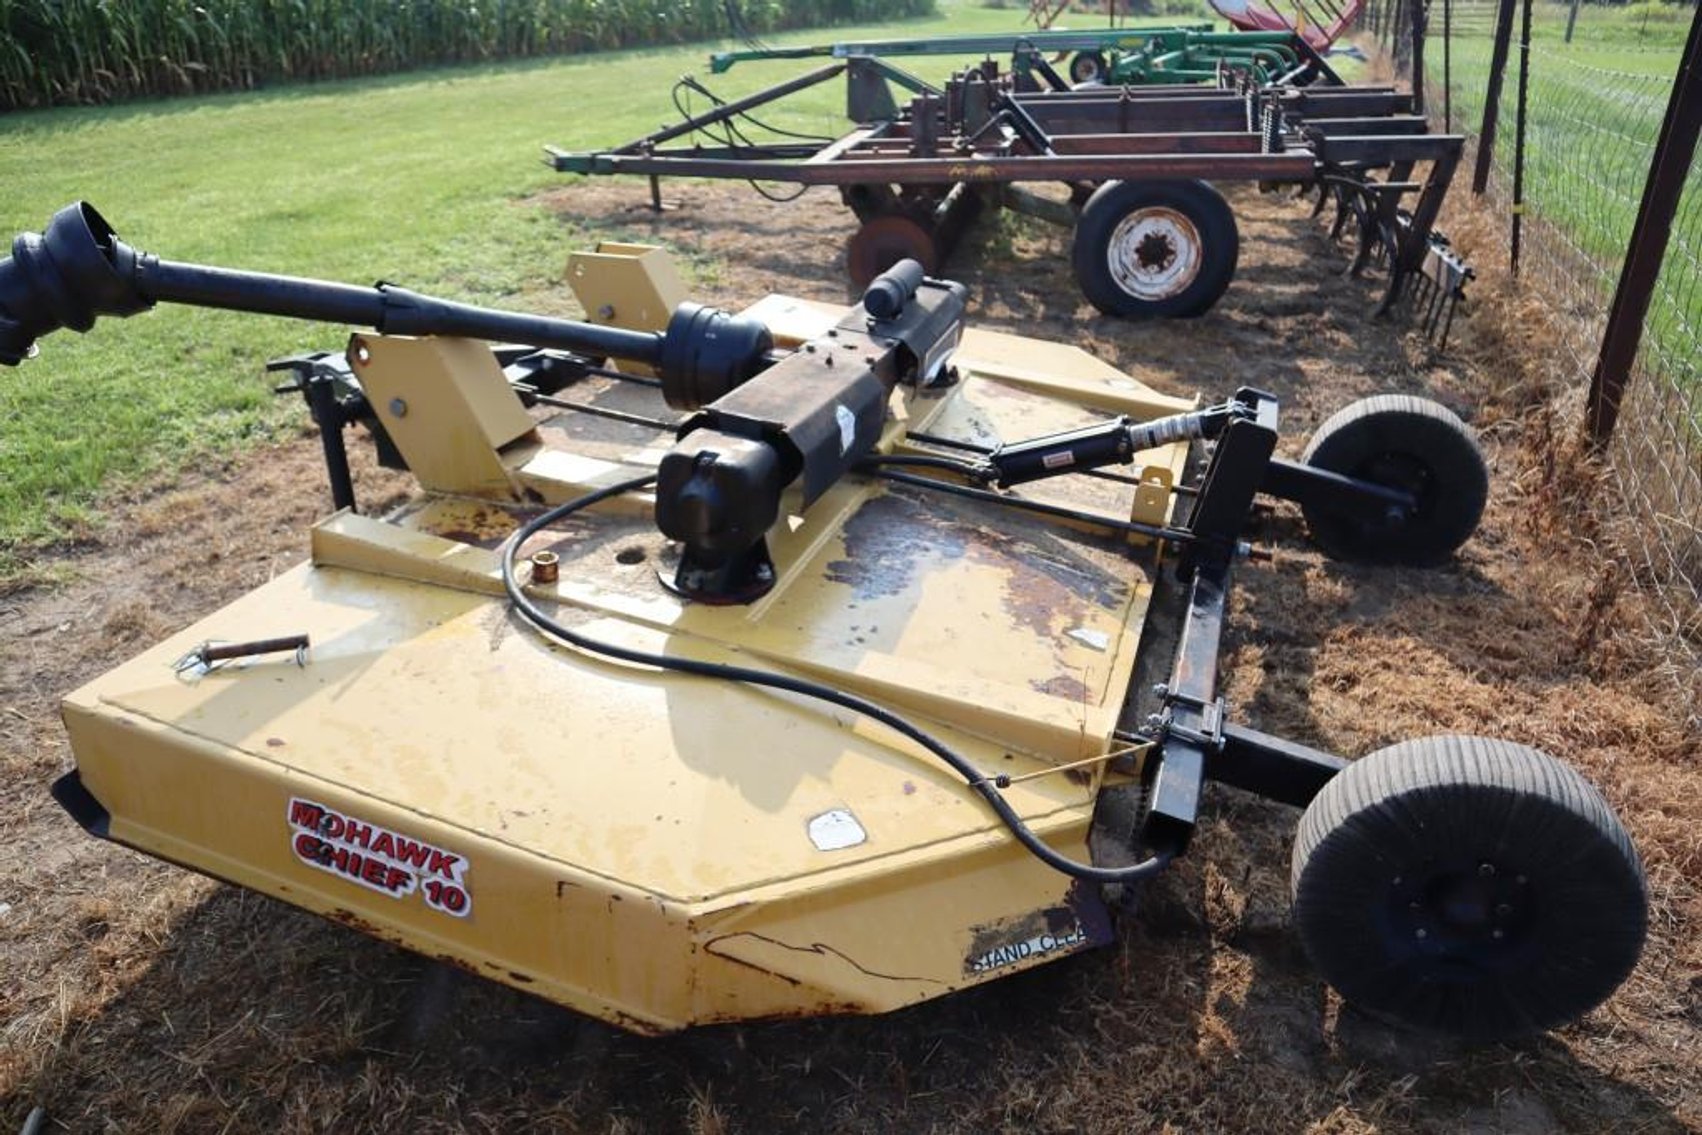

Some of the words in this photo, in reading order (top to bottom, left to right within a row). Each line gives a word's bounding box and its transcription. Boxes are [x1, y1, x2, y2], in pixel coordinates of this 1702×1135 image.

[291, 800, 460, 880] MOHAWK
[295, 834, 412, 892] CHIEF
[426, 880, 466, 912] 10
[973, 940, 1032, 973] STAND
